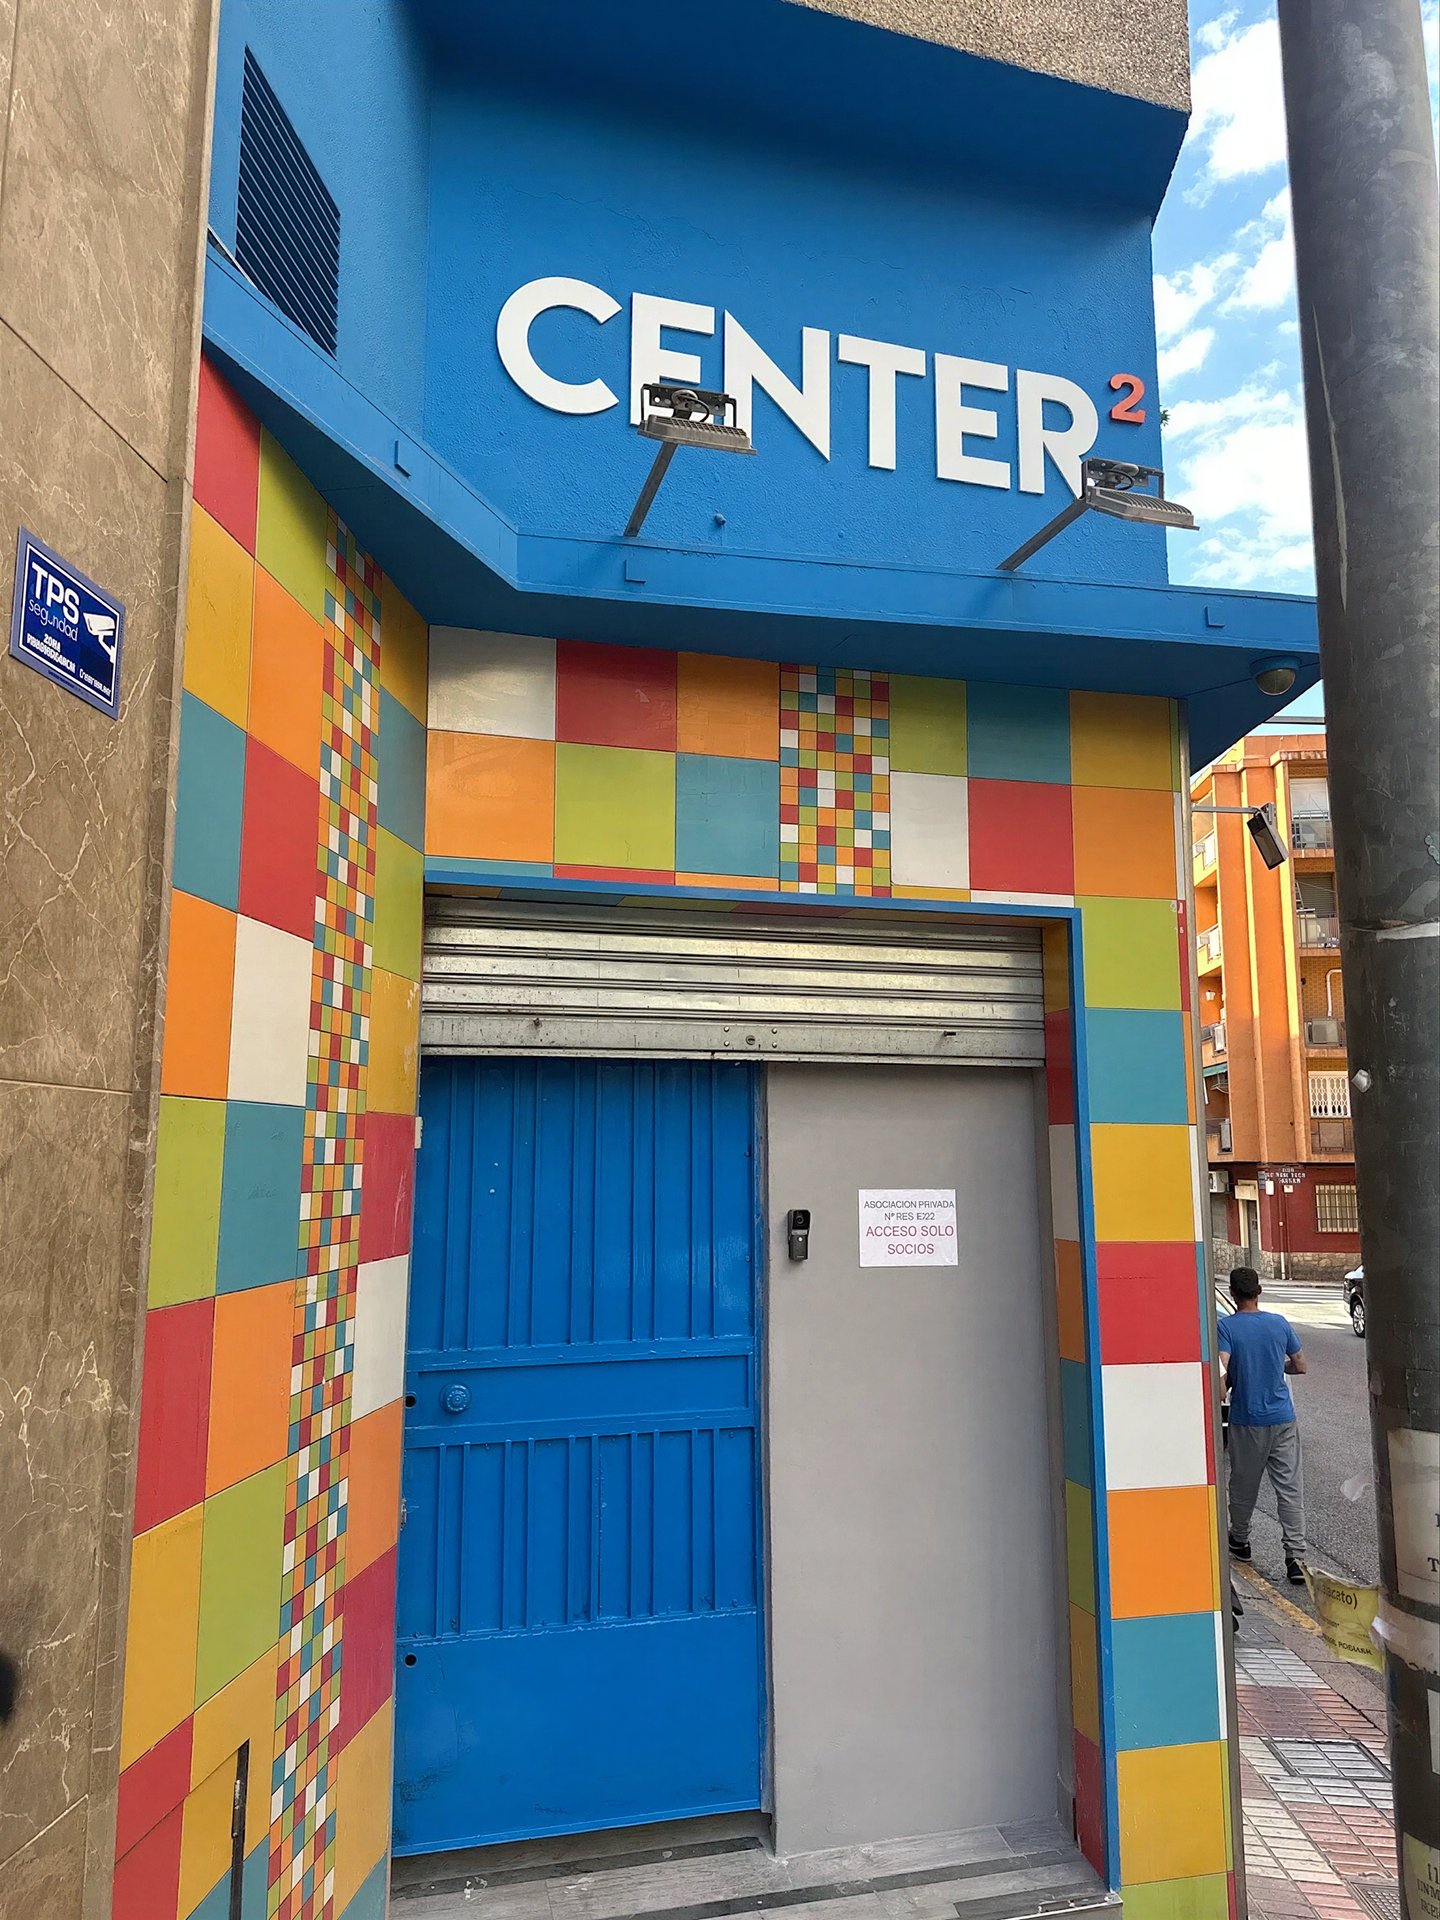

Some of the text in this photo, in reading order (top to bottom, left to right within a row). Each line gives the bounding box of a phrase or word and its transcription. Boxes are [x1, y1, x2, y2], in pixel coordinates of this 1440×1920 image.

[496, 276, 1146, 498] CENTER 2
[31, 561, 80, 625] TPS
[864, 1200, 955, 1209] ASOCIACION PRIVADA
[896, 1212, 914, 1220] RES
[866, 1225, 954, 1237] ACCESO SOLO
[887, 1243, 935, 1255] SOCIOS
